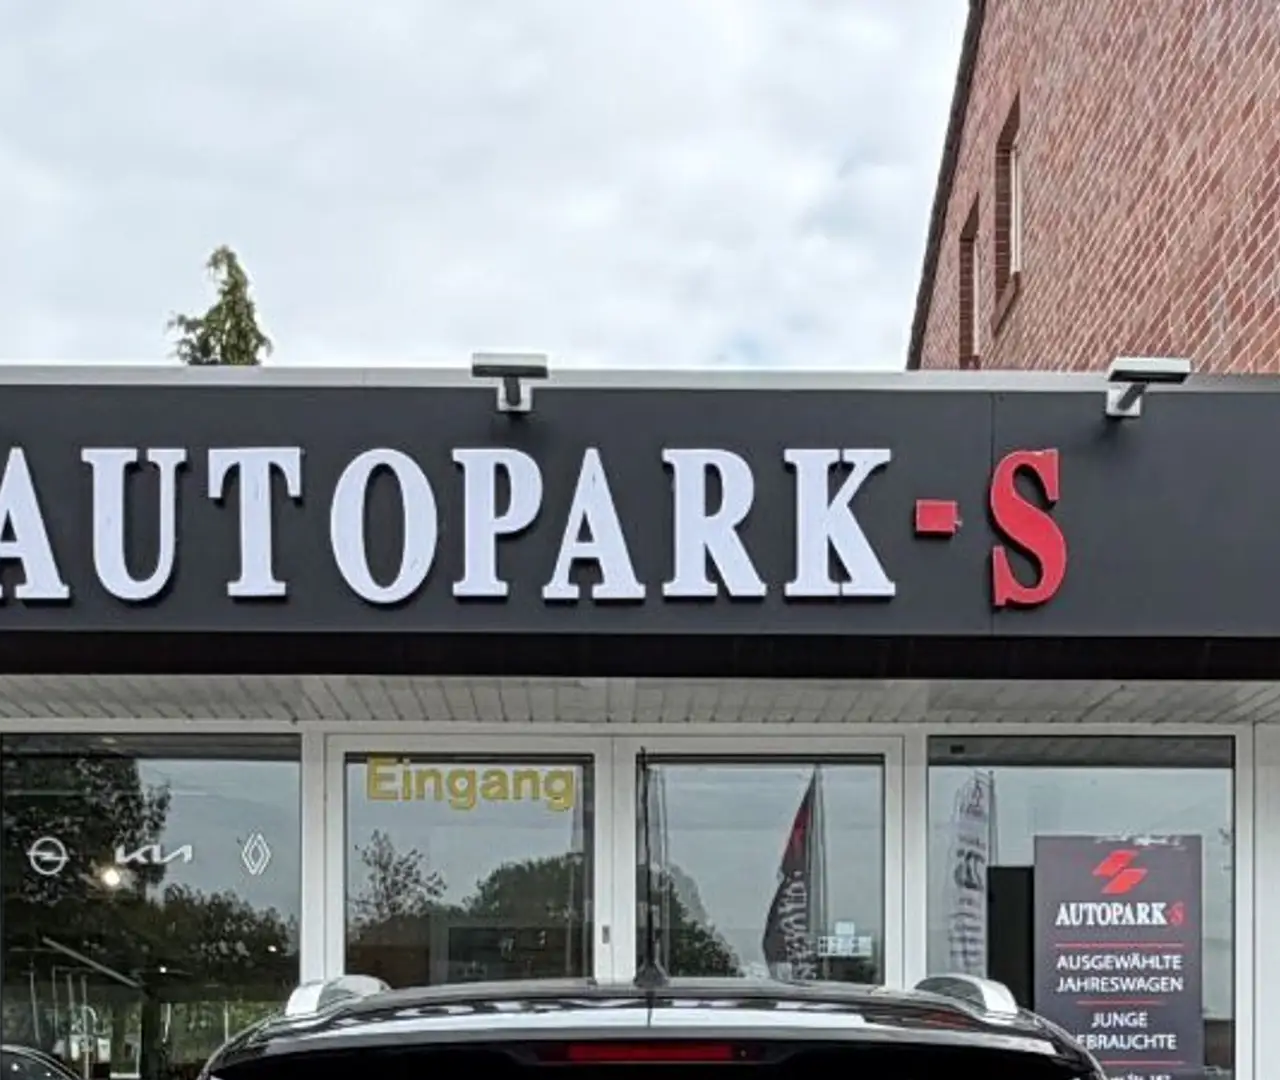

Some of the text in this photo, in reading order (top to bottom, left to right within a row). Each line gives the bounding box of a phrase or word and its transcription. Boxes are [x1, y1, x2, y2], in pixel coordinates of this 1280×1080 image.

[367, 756, 575, 812] Eingang
[1056, 953, 1182, 971] AUSGEWÄHLTE
[1056, 976, 1184, 993] JAHRESWAGEN
[1091, 1012, 1148, 1028] JUNGE
[1076, 1033, 1177, 1050] EBRAUCHTE
